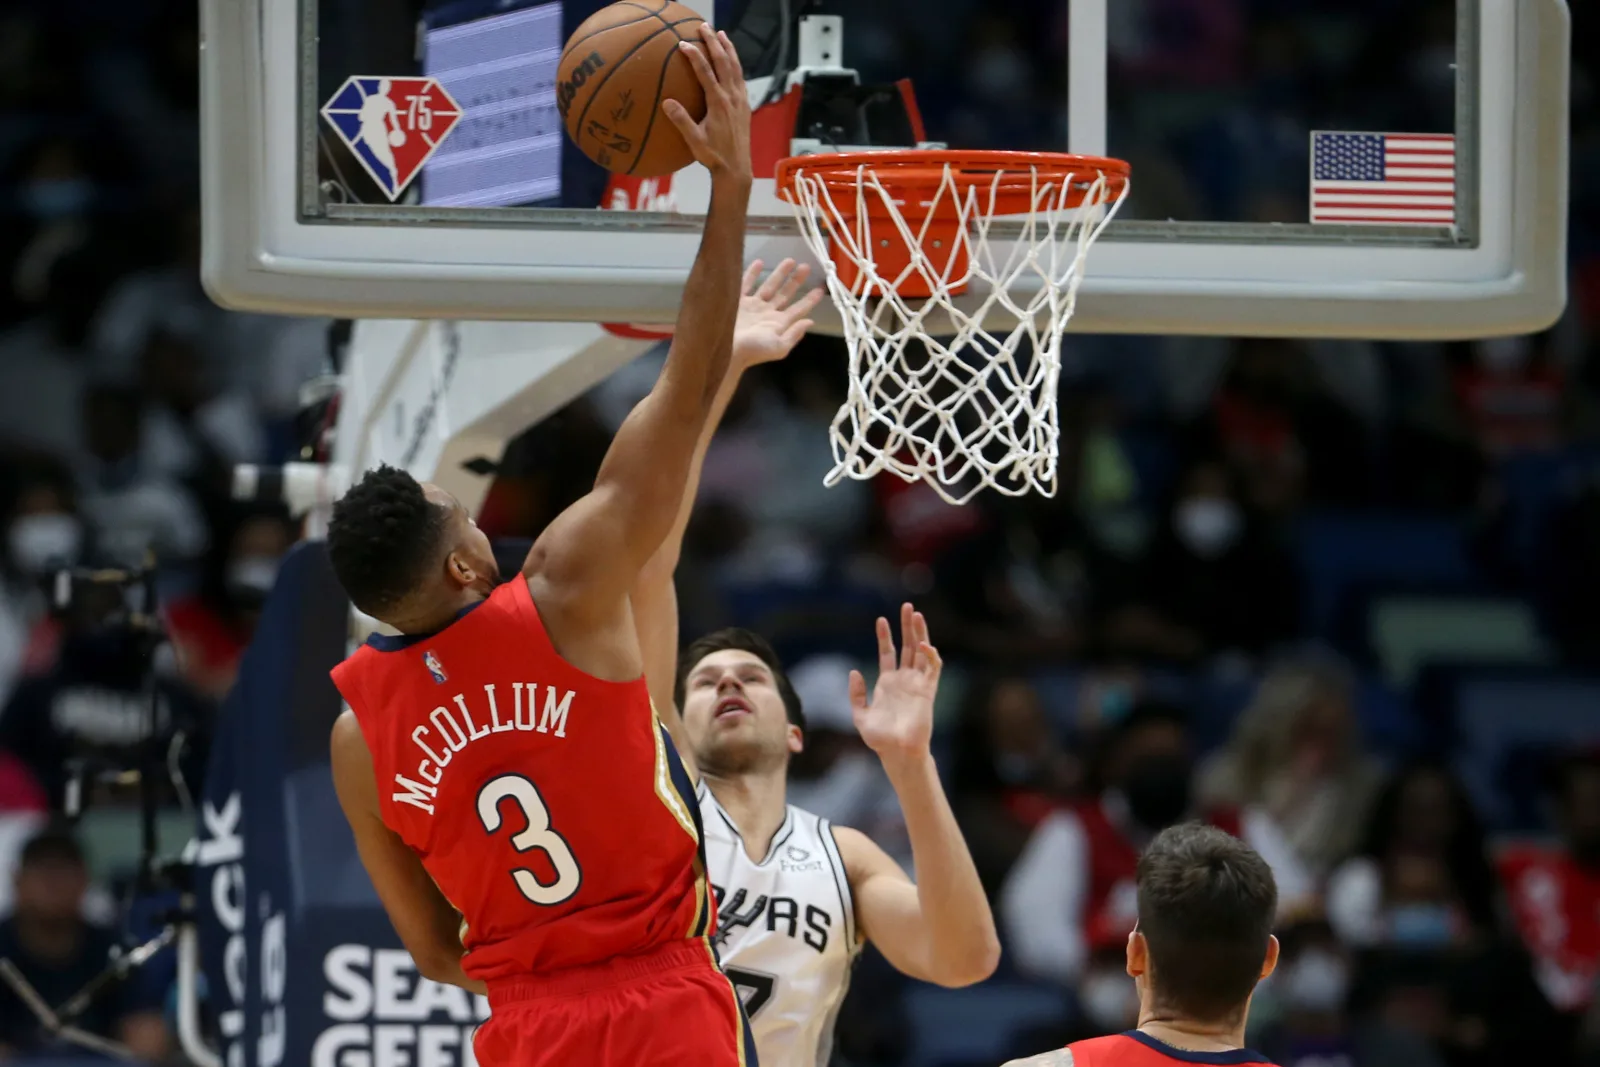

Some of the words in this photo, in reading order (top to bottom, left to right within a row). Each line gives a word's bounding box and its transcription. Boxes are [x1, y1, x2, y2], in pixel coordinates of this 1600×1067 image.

[405, 95, 432, 130] 75
[393, 683, 576, 815] McCOLLUM
[475, 772, 583, 907] 3
[711, 883, 832, 954] URS
[323, 943, 492, 1021] SEA
[311, 1024, 480, 1067] GEE
